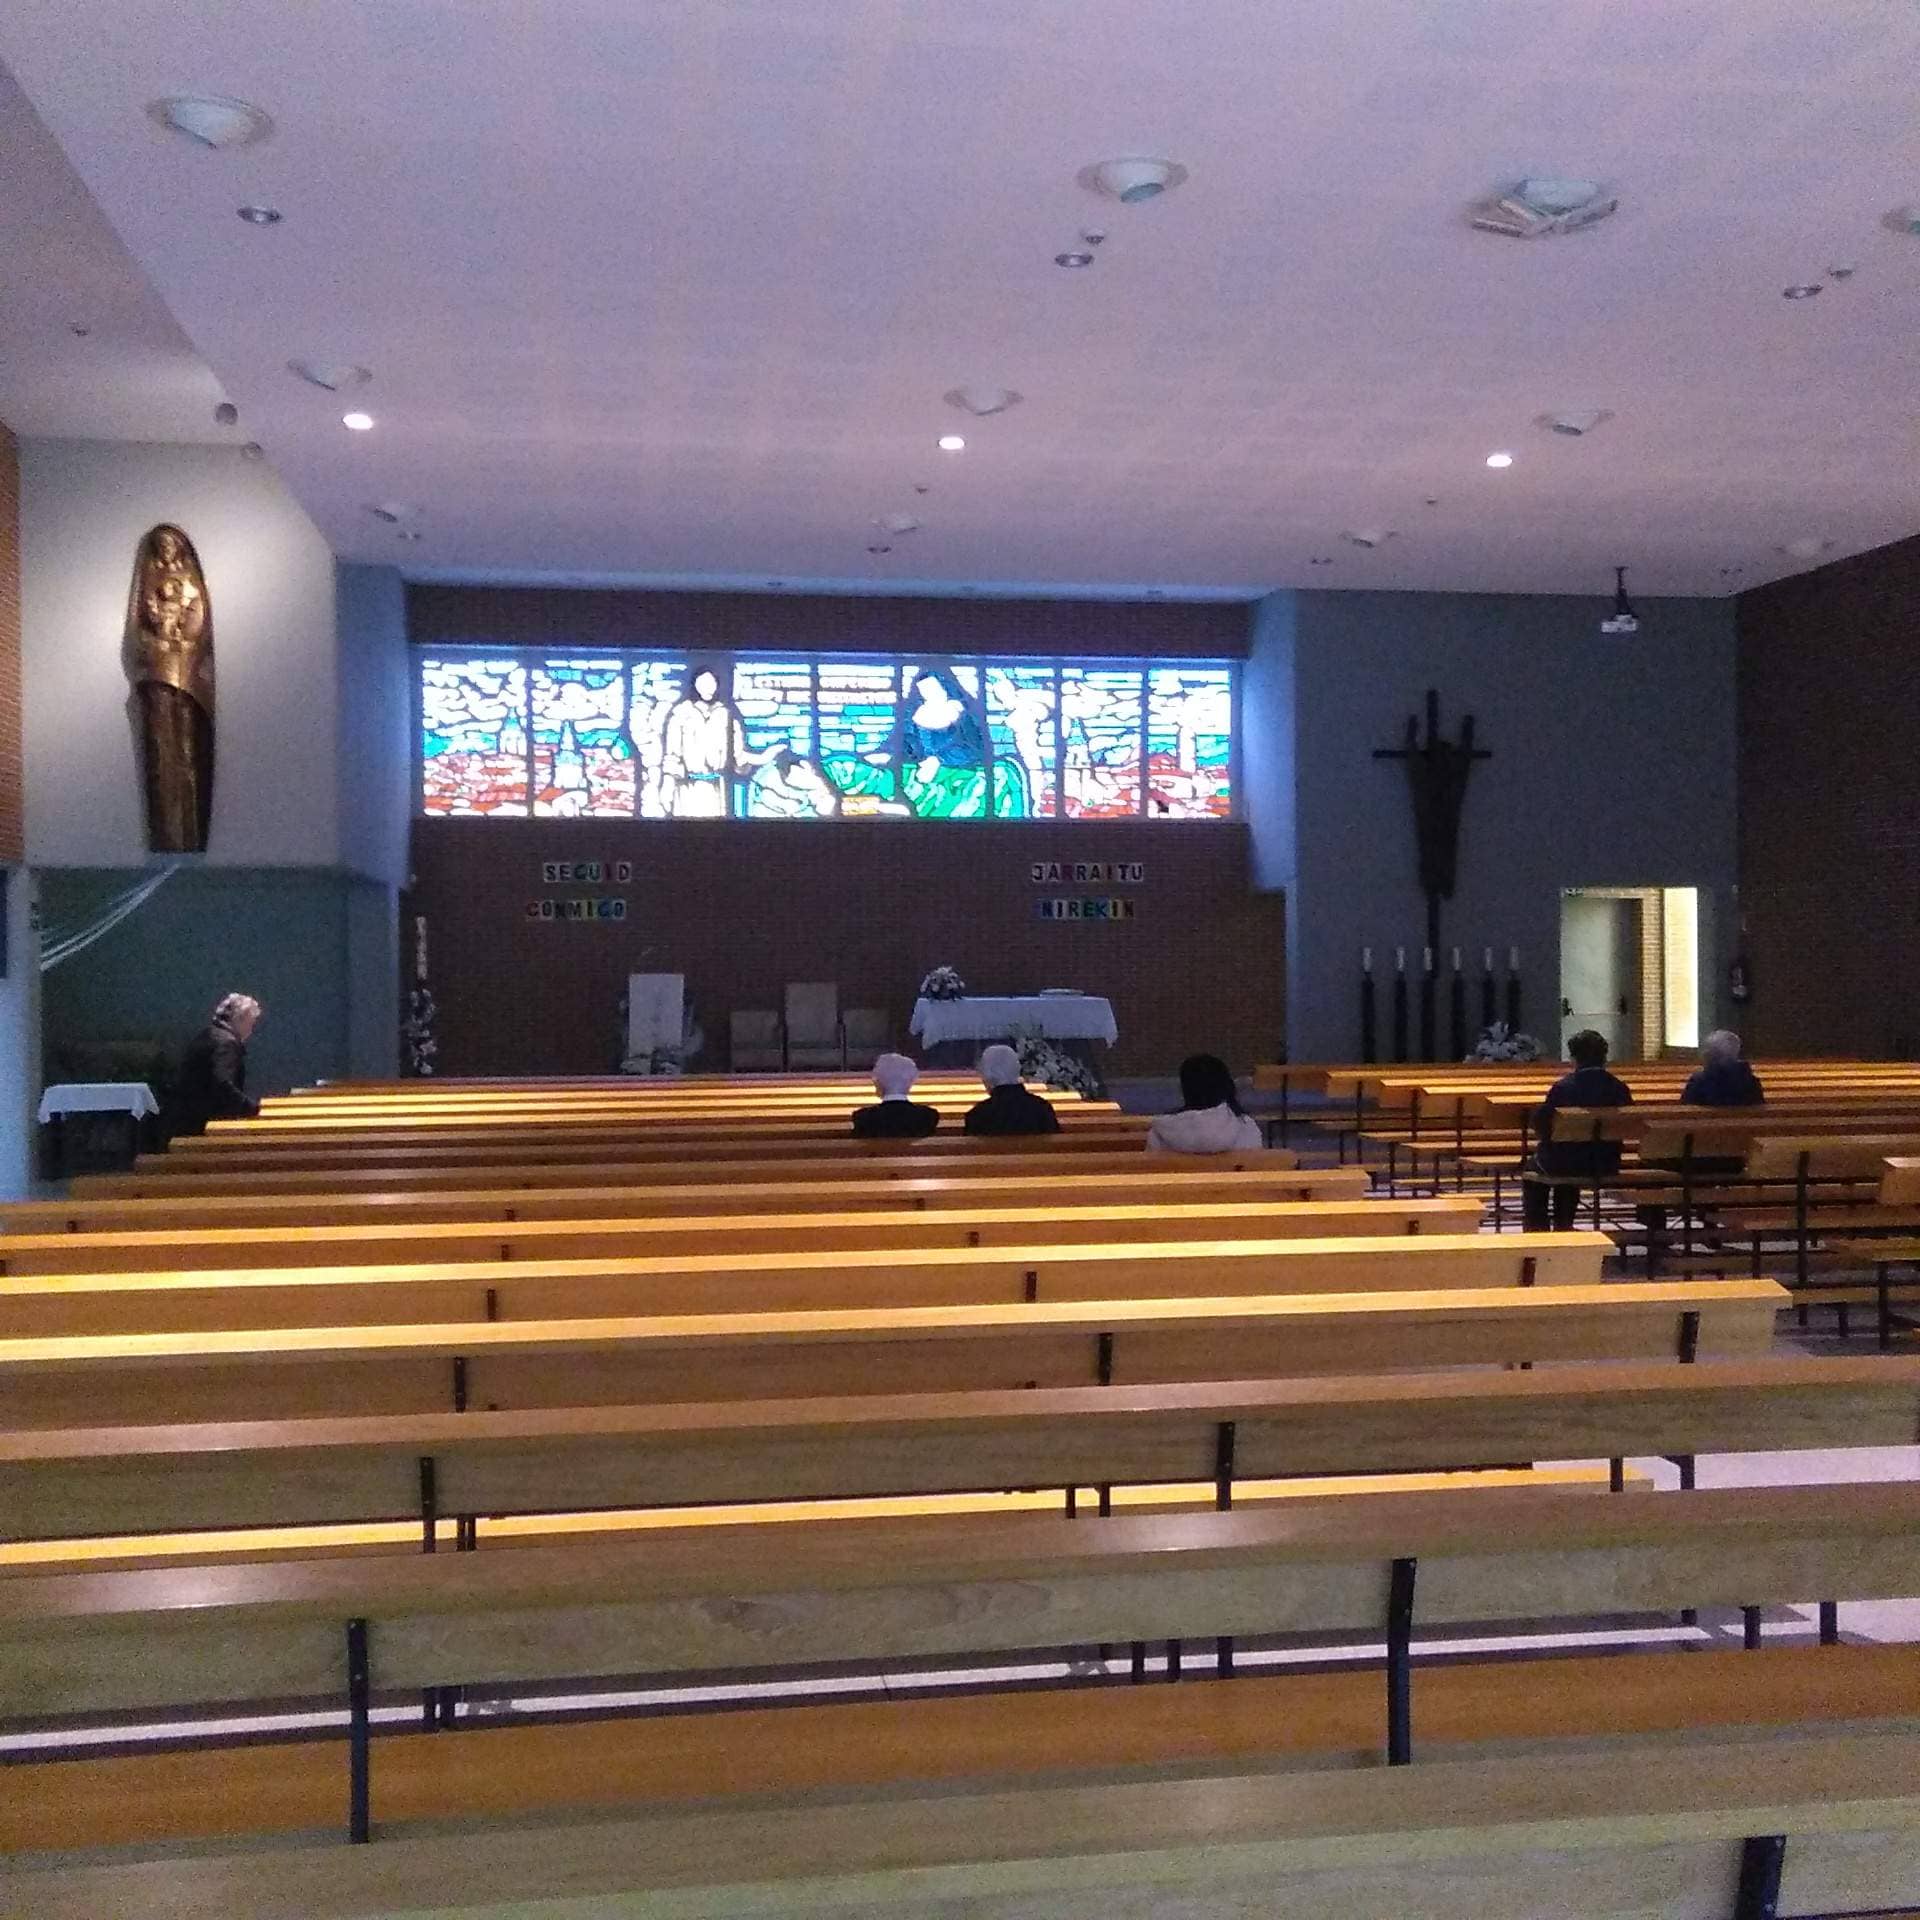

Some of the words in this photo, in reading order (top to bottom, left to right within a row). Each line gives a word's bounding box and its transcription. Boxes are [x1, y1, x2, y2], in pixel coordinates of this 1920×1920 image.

[545, 863, 630, 882] SEGUID
[1031, 863, 1143, 882] JARRAITU
[1041, 900, 1135, 918] NIREKIN
